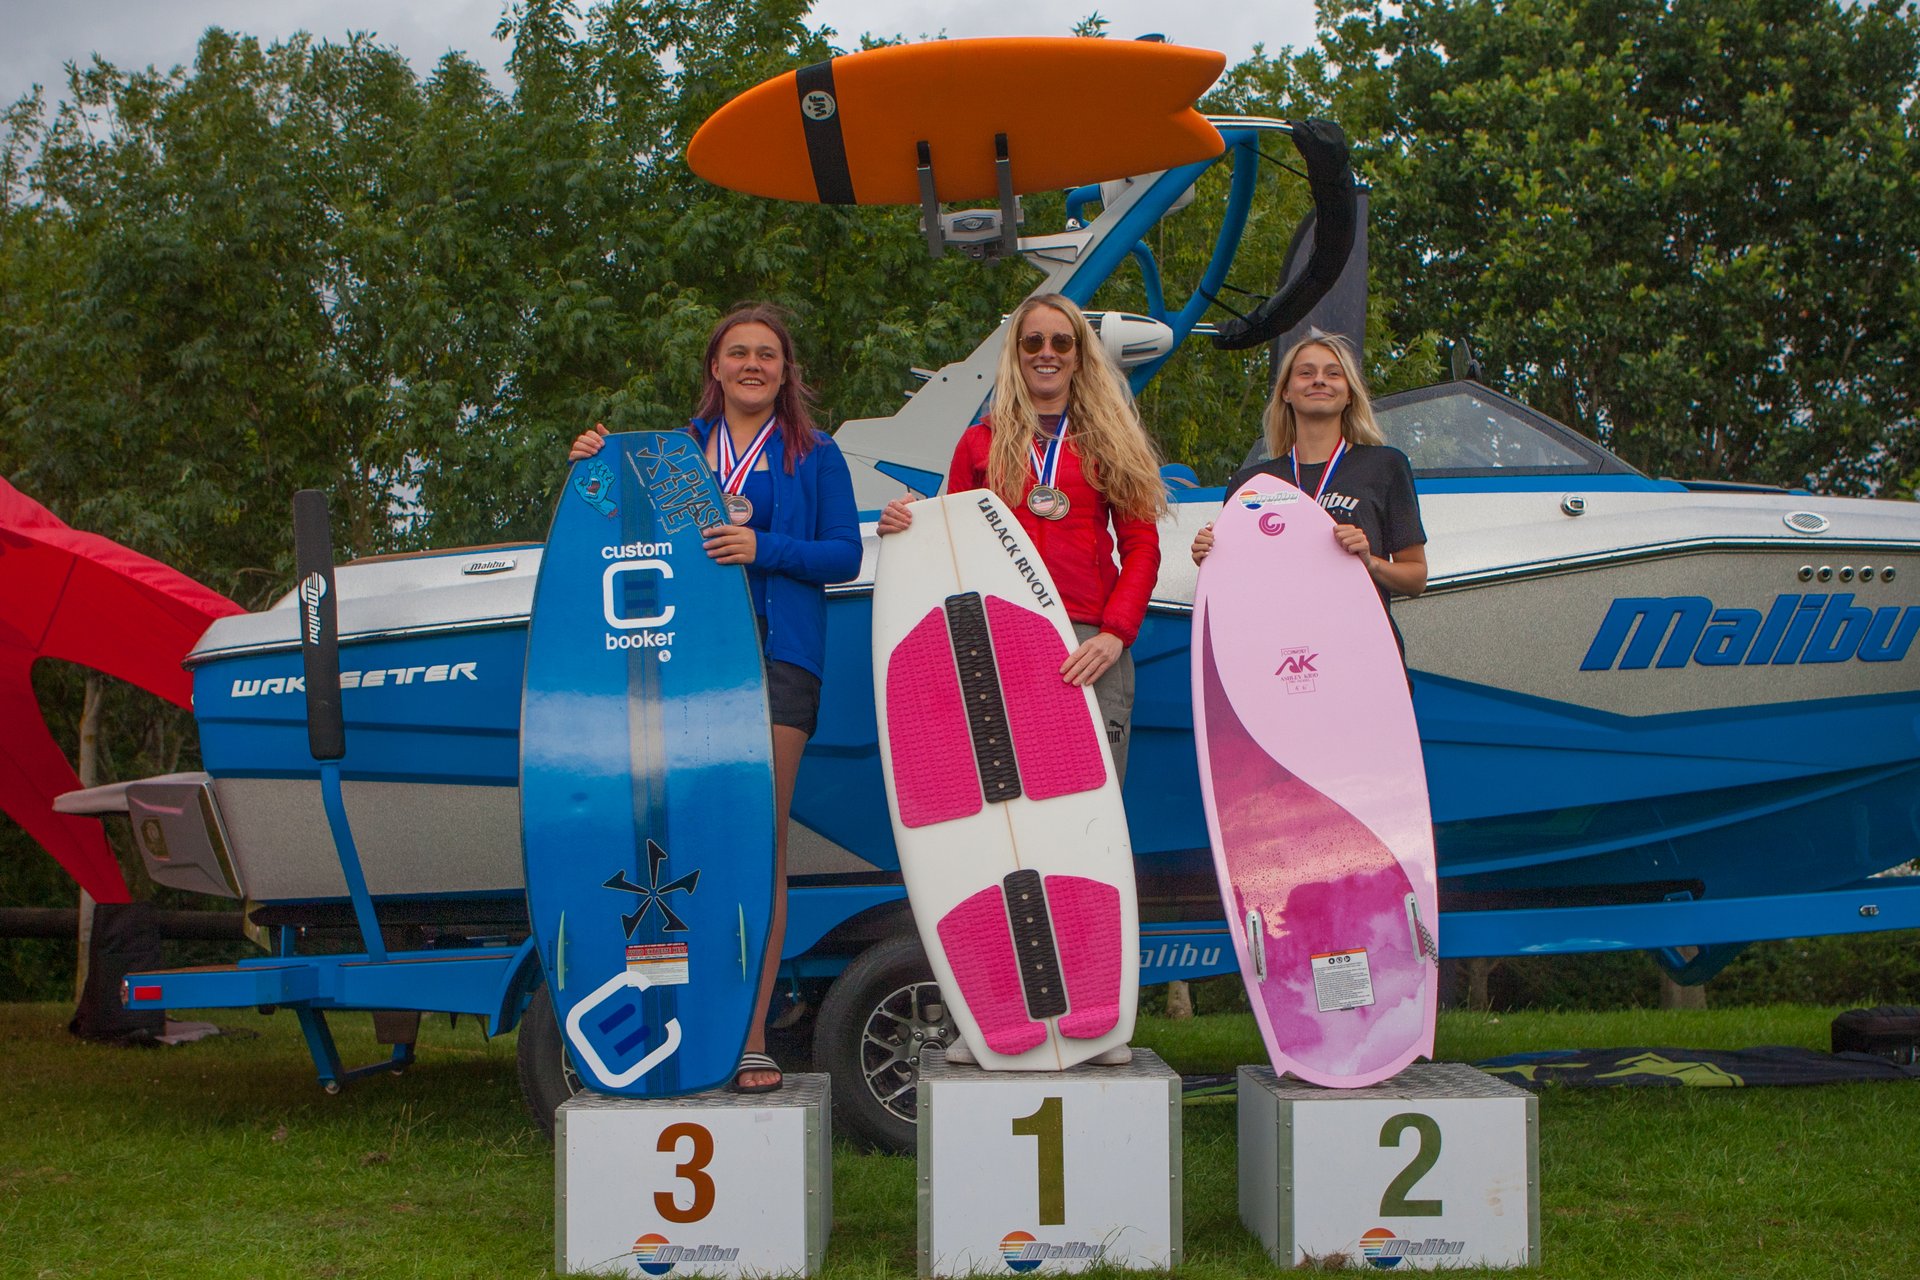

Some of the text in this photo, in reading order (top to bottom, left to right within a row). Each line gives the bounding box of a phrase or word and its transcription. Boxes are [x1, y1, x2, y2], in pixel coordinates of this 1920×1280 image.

[650, 475, 695, 525] FIVE
[1318, 491, 1360, 511] libu
[601, 541, 673, 560] custom
[985, 510, 1055, 609] BLACK REVOLT
[470, 561, 506, 571] Malibu
[306, 585, 321, 645] Malibu
[605, 630, 676, 651] booker
[1579, 593, 1920, 671] Malibu
[1275, 653, 1319, 676] AK
[231, 662, 478, 697] WAKSETTER
[1139, 943, 1221, 968] alibu
[653, 1121, 716, 1224] 3
[1011, 1096, 1066, 1226] 1
[1378, 1112, 1443, 1217] 2
[652, 1244, 740, 1262] Malibu
[1020, 1241, 1106, 1259] Malibu
[1380, 1238, 1465, 1256] Malibu
